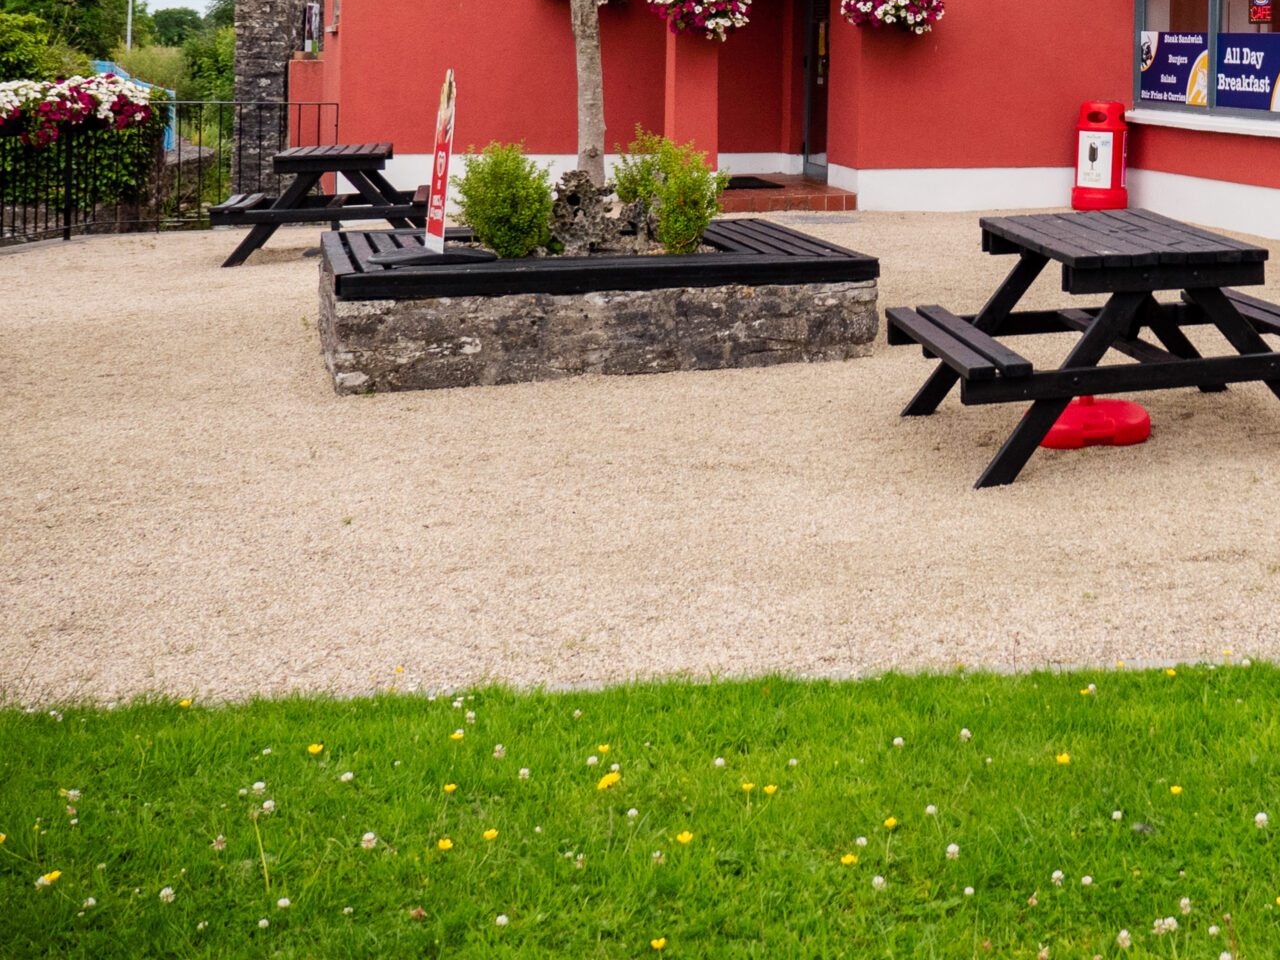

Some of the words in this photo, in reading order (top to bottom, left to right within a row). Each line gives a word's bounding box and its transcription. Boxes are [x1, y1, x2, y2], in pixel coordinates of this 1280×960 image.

[1251, 6, 1271, 19] CAFE
[1164, 34, 1178, 44] Steak
[1179, 34, 1203, 44] Sandwich
[1168, 54, 1188, 66] Burgers
[1223, 47, 1240, 64] All
[1242, 47, 1264, 70] Day
[1217, 73, 1270, 93] Breakfast
